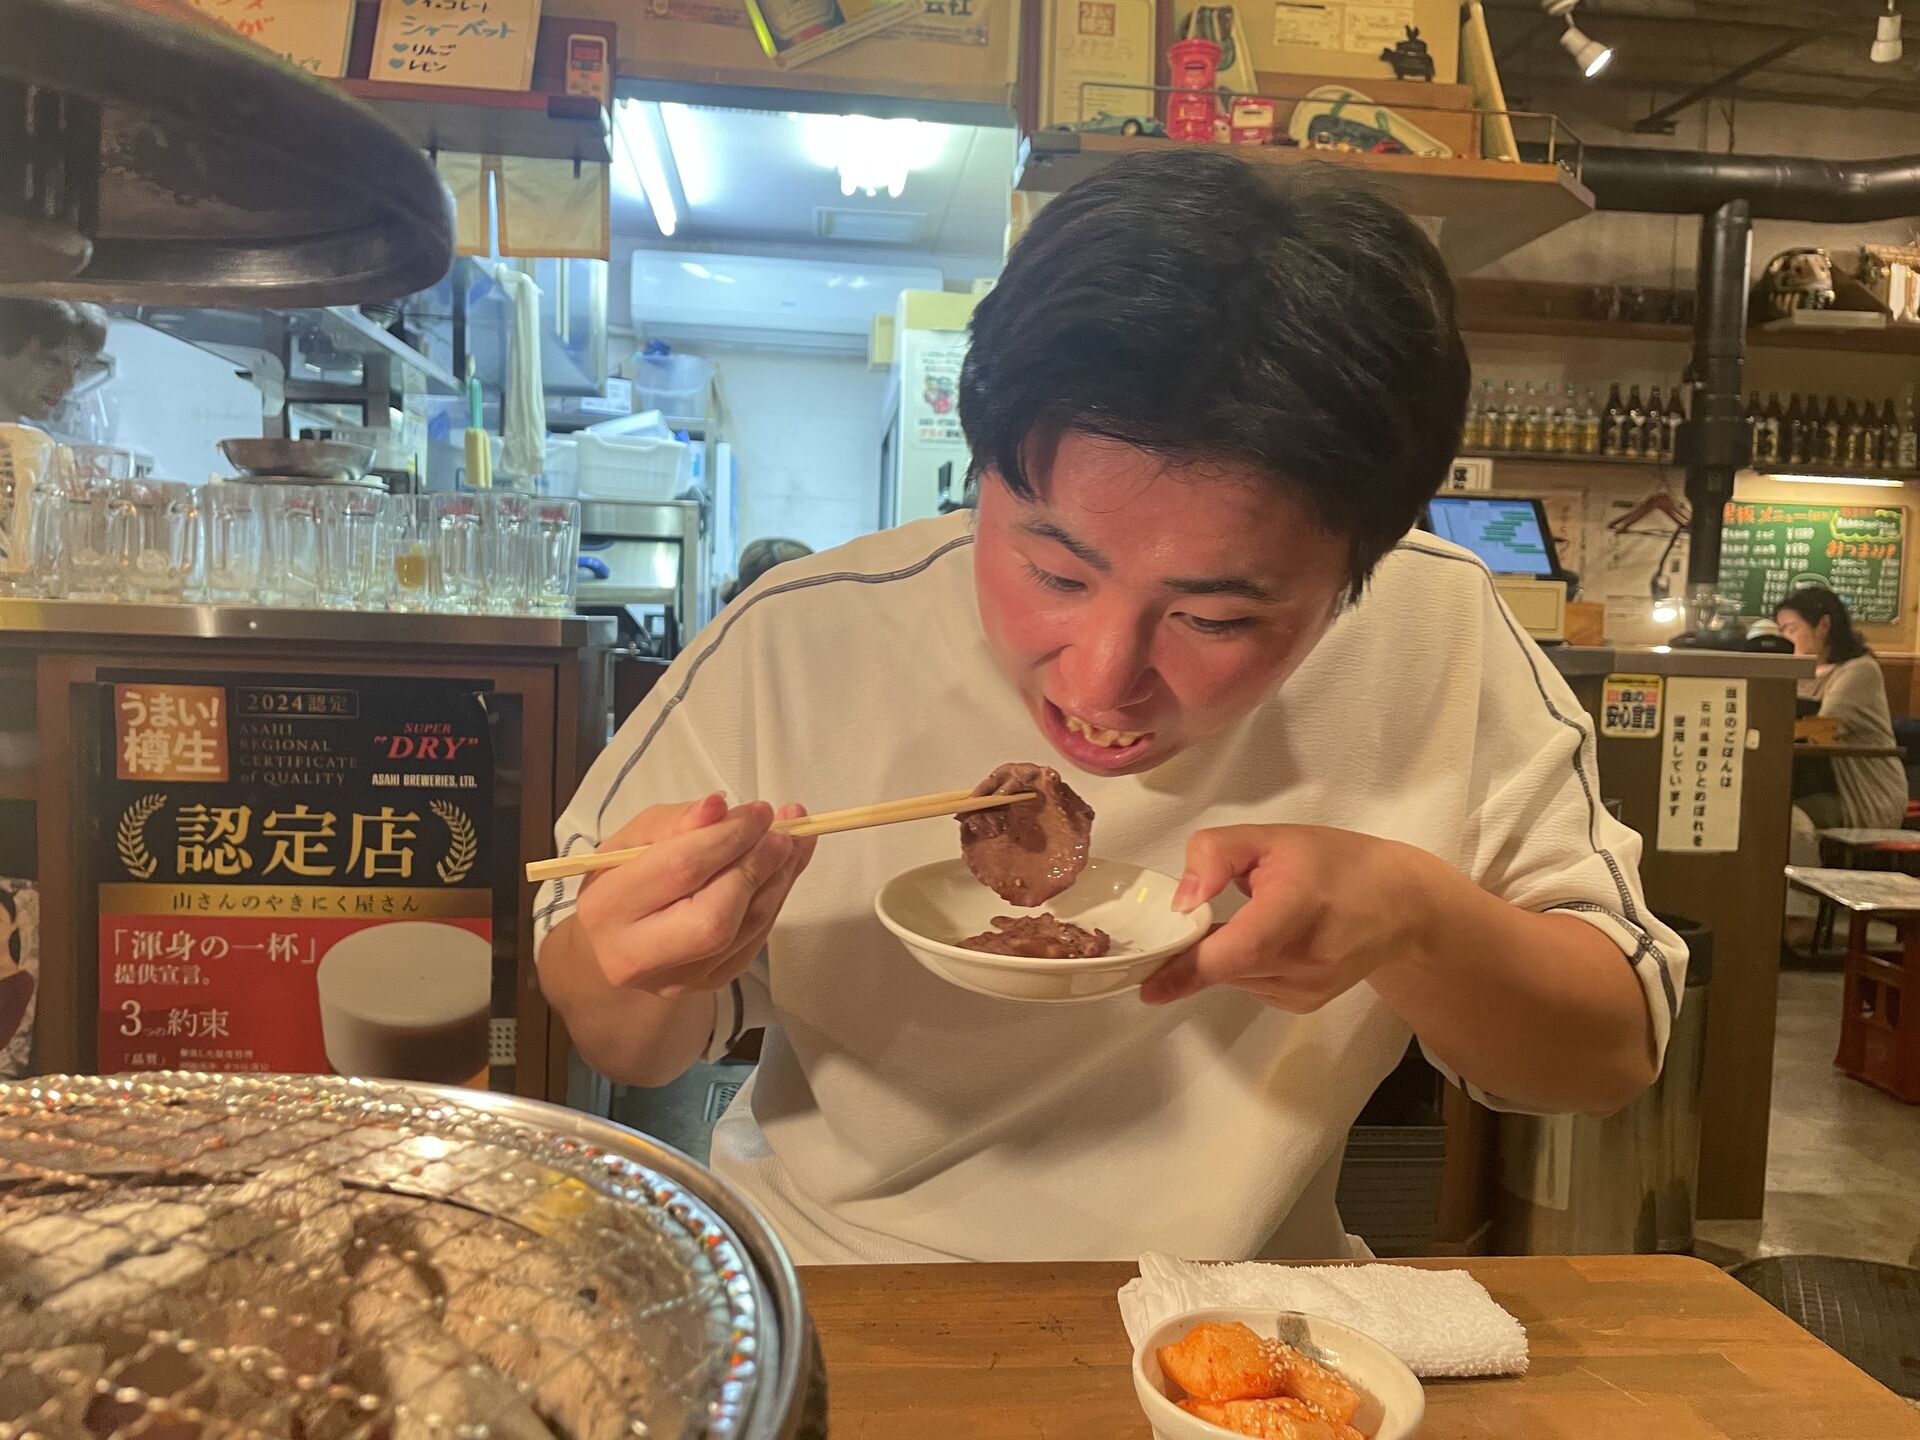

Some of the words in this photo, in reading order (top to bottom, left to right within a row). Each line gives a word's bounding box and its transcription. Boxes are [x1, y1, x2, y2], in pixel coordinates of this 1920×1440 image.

[401, 15, 517, 39] シャーベット
[412, 43, 456, 56] りんご
[409, 60, 448, 72] レモン
[120, 691, 220, 727] うまい!
[1606, 704, 1656, 729] 安心宣言
[240, 723, 293, 736] ASAHI
[404, 723, 452, 734] SUPER
[1720, 686, 1738, 788] 当店のごはんは
[124, 728, 221, 773] 樽生
[240, 737, 331, 752] REGIONAL
[240, 754, 358, 769] CERTIFICATE
[1669, 715, 1686, 817] 使用しています
[240, 771, 257, 783] of
[264, 772, 345, 786] QUALITY
[372, 773, 400, 786] ASAHI
[176, 803, 421, 878] 認定店
[173, 891, 420, 912] 山さんのやきにく屋さん
[114, 929, 316, 964] 「渾身の一杯」
[114, 964, 210, 985] 提供宣言。
